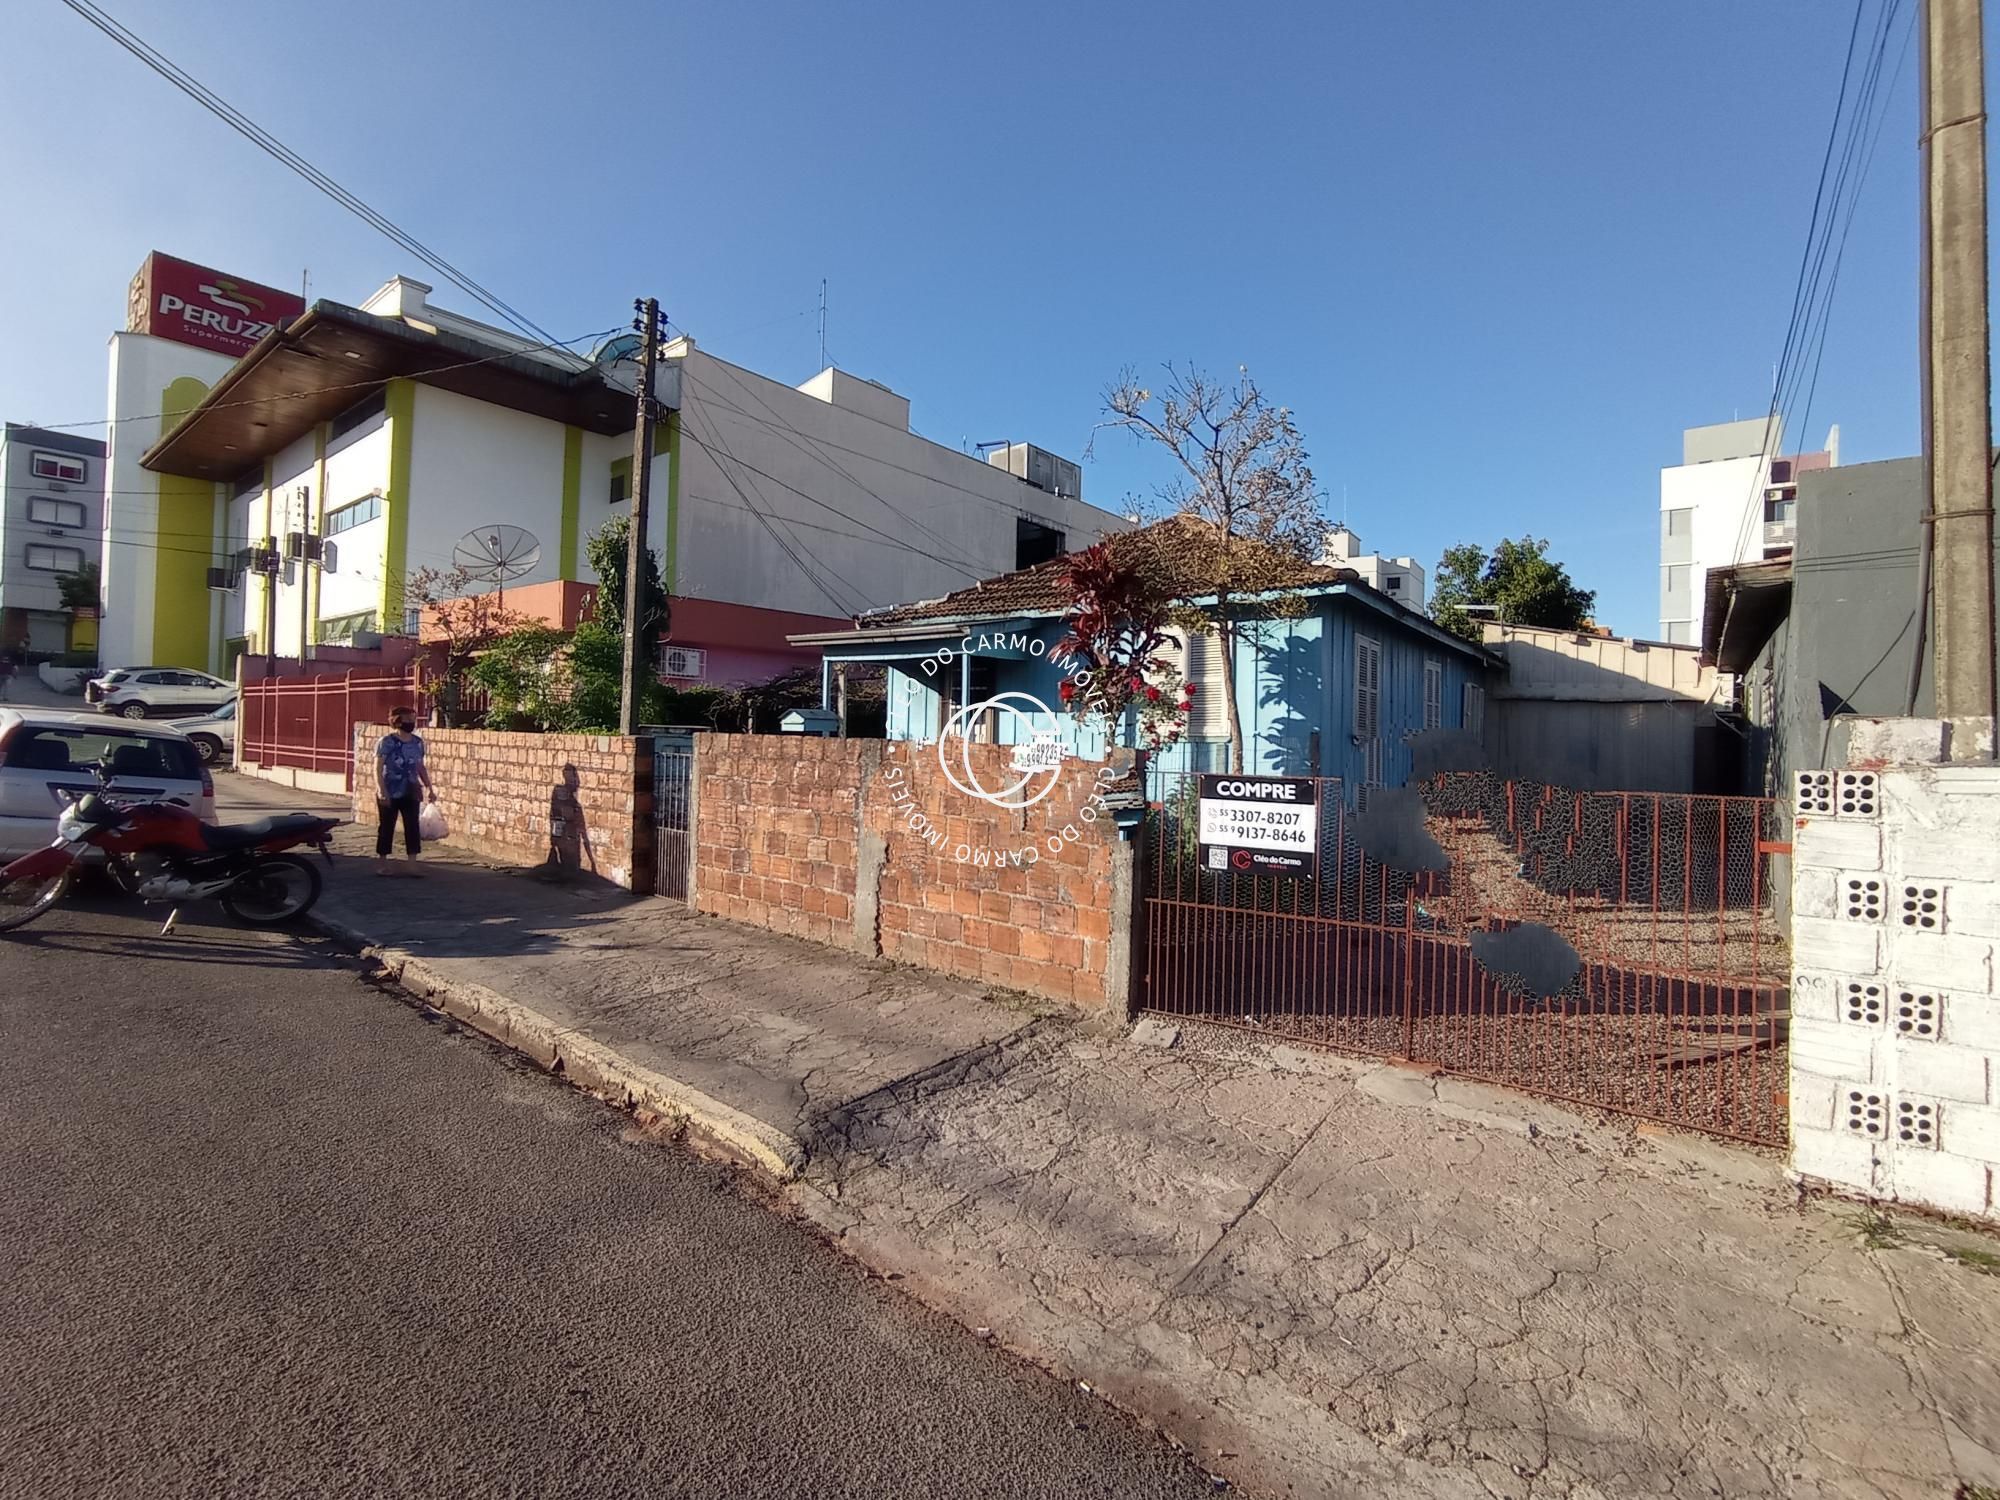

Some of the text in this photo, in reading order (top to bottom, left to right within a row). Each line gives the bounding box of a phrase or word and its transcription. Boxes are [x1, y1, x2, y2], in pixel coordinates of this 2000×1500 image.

[1216, 781, 1296, 799] COMPRE
[1219, 809, 1300, 825] 55 3307-8207
[1237, 826, 1306, 843] 9137-8646
[1270, 855, 1279, 863] do
[1279, 857, 1302, 866] Carmo
